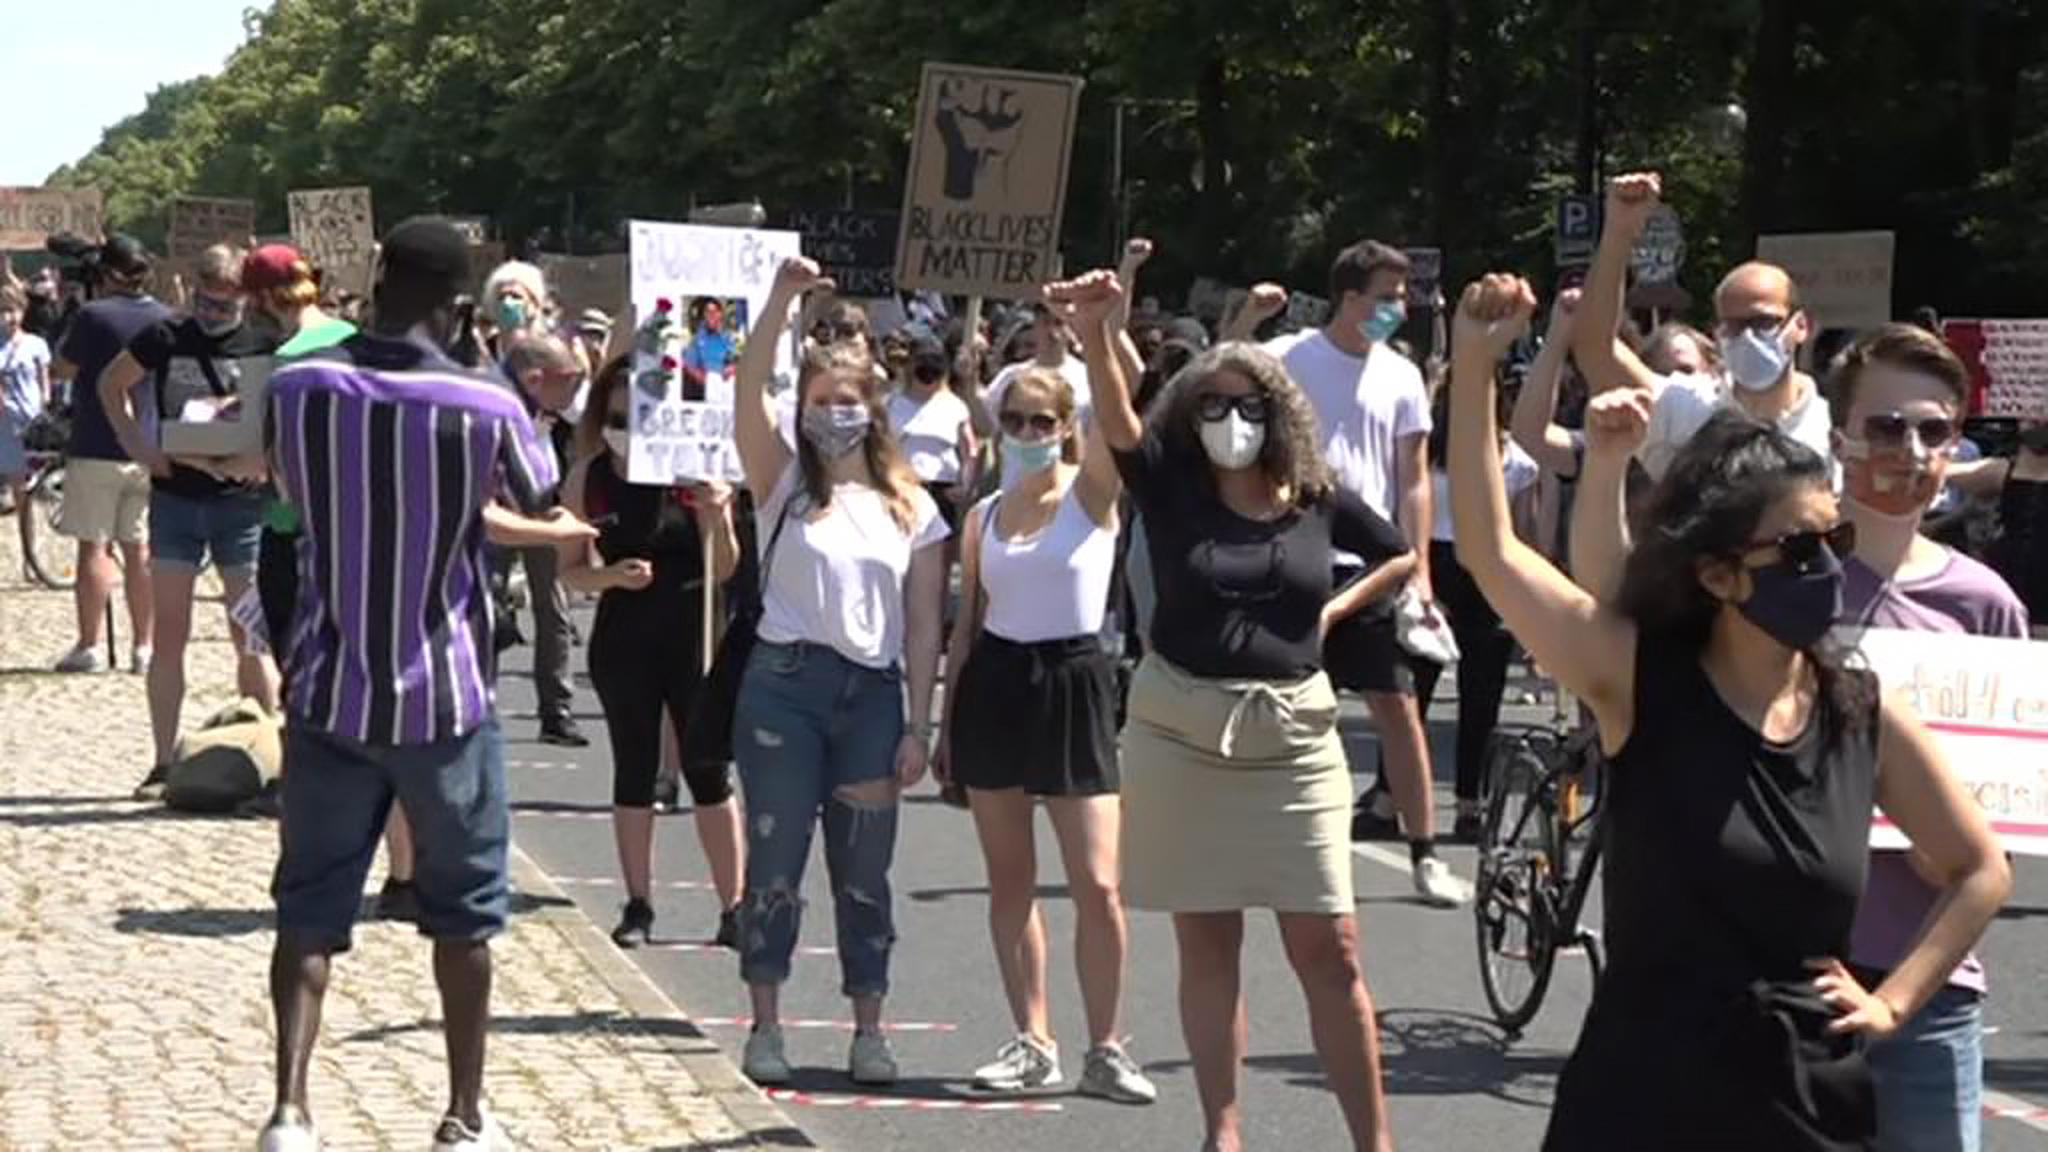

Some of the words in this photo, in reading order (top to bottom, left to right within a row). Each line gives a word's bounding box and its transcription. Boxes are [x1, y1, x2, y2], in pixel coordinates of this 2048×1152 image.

[1566, 201, 1588, 235] P
[920, 243, 1037, 282] MATTER
[646, 441, 741, 479] TAYL
